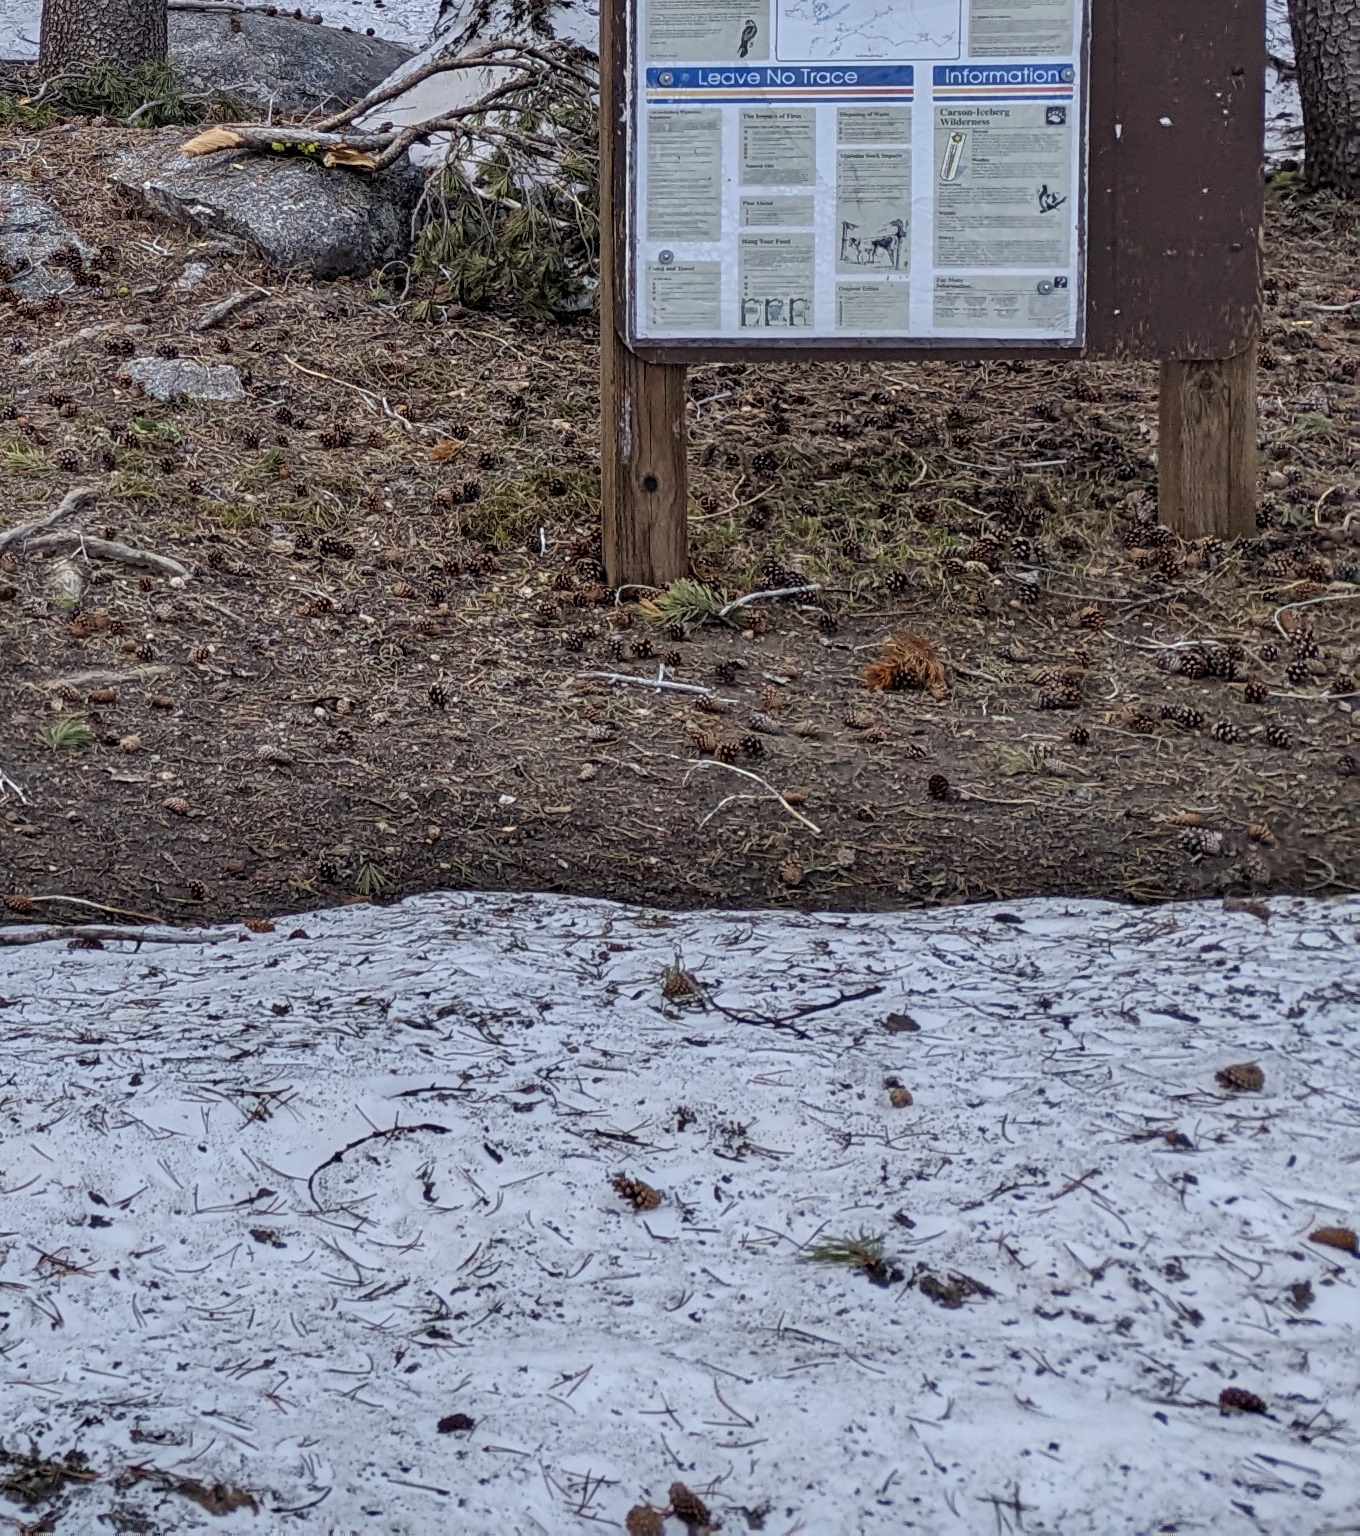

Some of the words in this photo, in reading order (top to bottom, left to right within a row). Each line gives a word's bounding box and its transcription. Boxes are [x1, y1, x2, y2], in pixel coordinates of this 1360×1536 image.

[698, 69, 761, 86] Leave
[766, 69, 796, 85] No
[800, 68, 858, 85] Trace
[945, 67, 1060, 84] Information
[940, 107, 1010, 117] Carson-Iceberg
[940, 118, 990, 126] Wilderness
